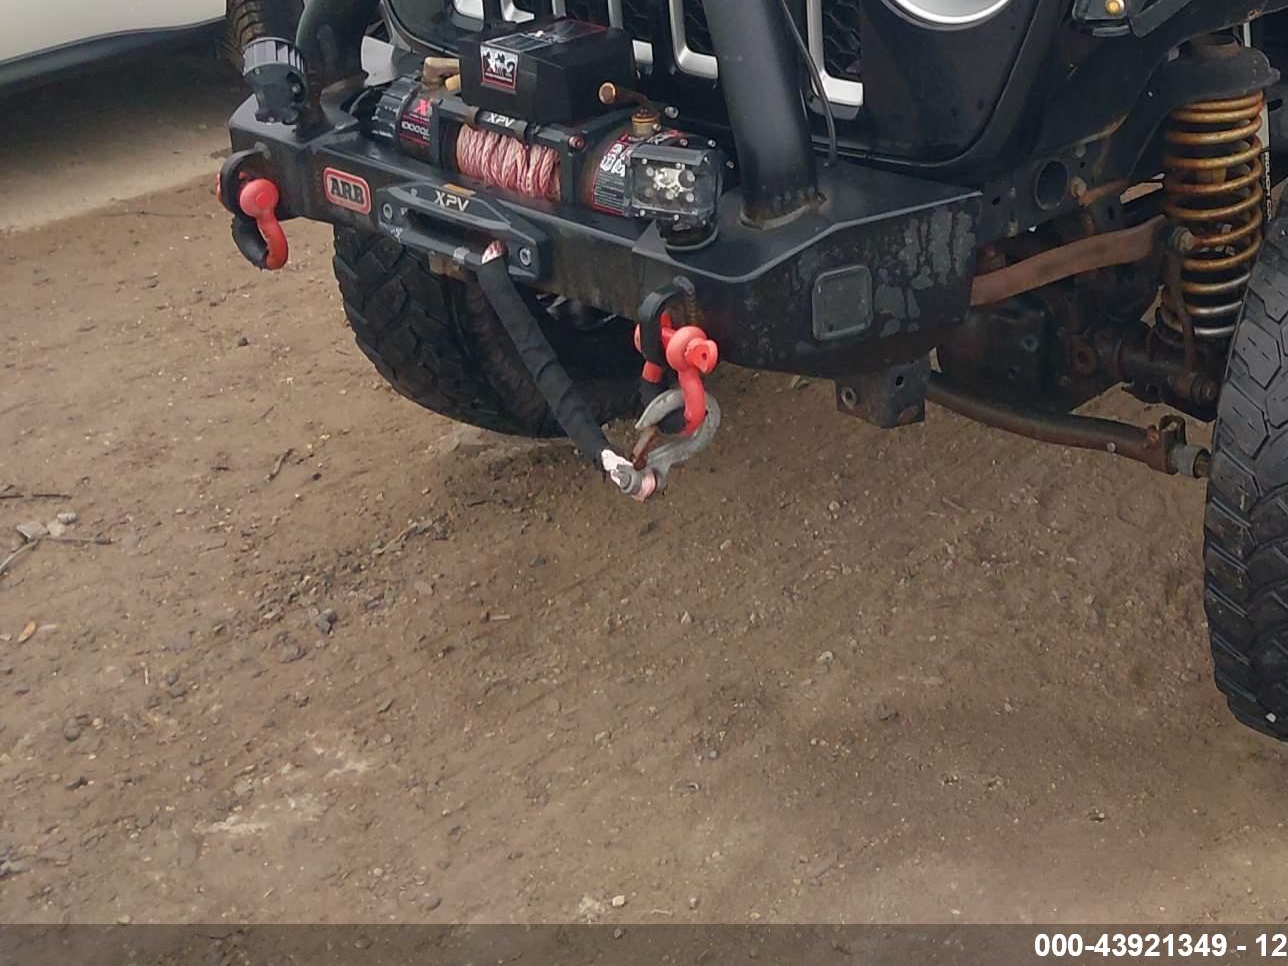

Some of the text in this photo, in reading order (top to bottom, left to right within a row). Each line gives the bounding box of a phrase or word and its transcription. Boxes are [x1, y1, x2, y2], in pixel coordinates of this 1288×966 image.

[487, 113, 515, 128] XPV
[331, 177, 364, 203] ARB
[434, 189, 470, 212] XPV
